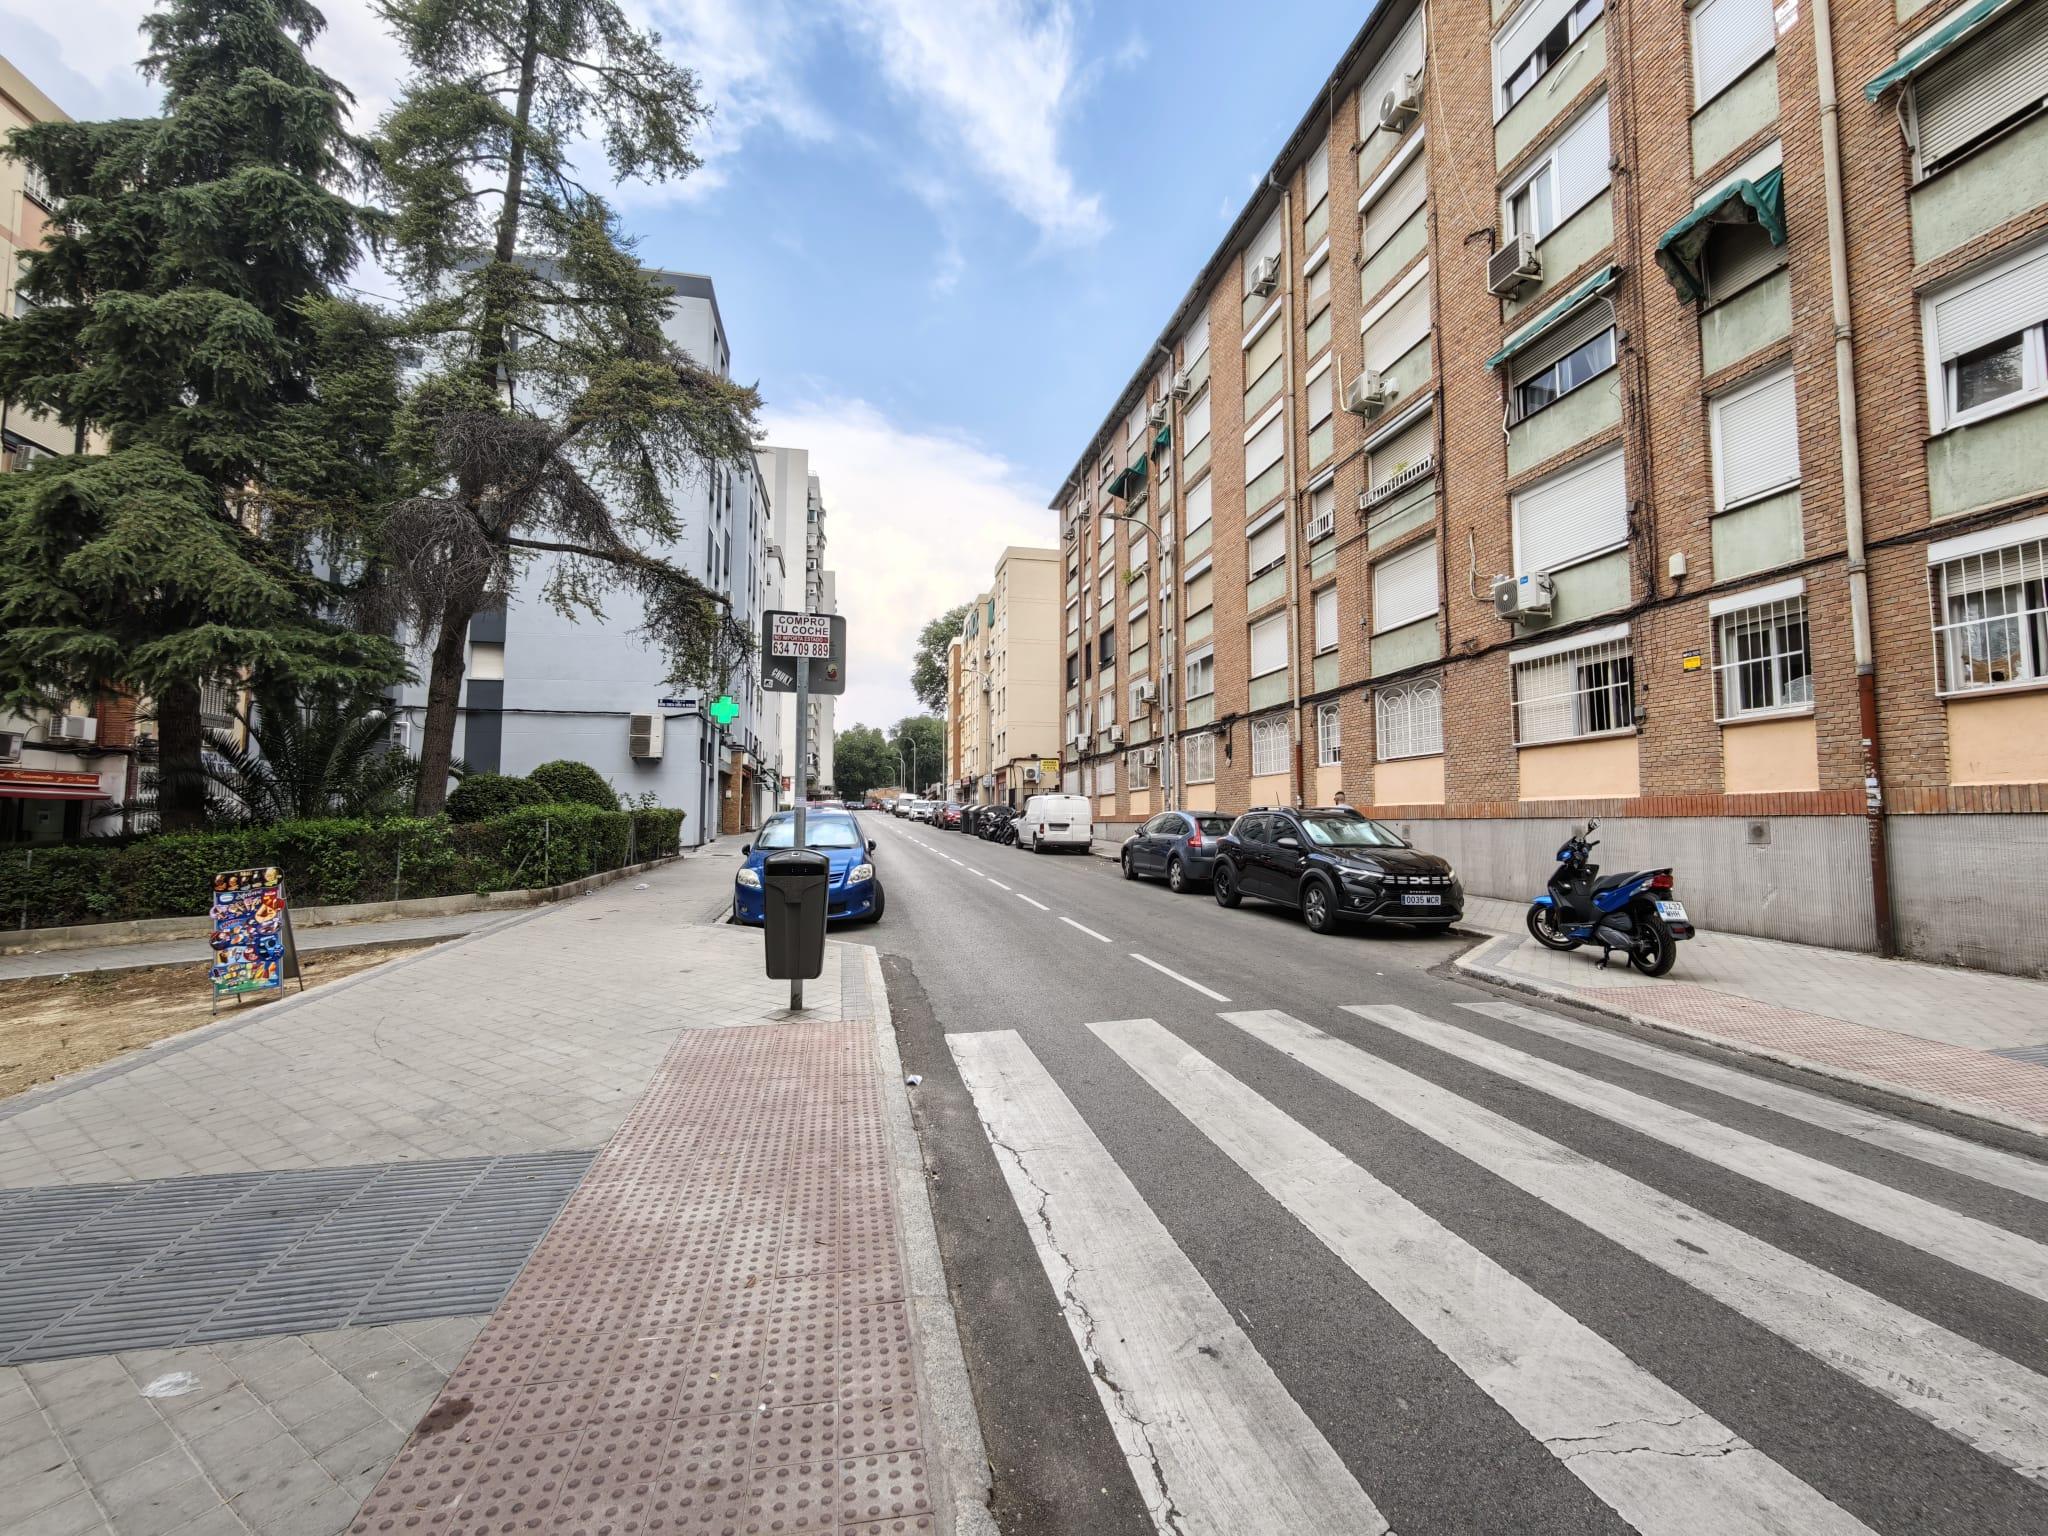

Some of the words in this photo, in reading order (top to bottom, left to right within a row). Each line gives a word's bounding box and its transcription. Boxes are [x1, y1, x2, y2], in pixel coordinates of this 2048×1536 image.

[779, 616, 825, 627] COMPRO
[774, 625, 788, 634] TU
[791, 626, 829, 636] COCHE
[773, 642, 789, 655] 634
[792, 643, 809, 656] 709
[812, 644, 829, 657] 889
[1406, 895, 1425, 904] 0035
